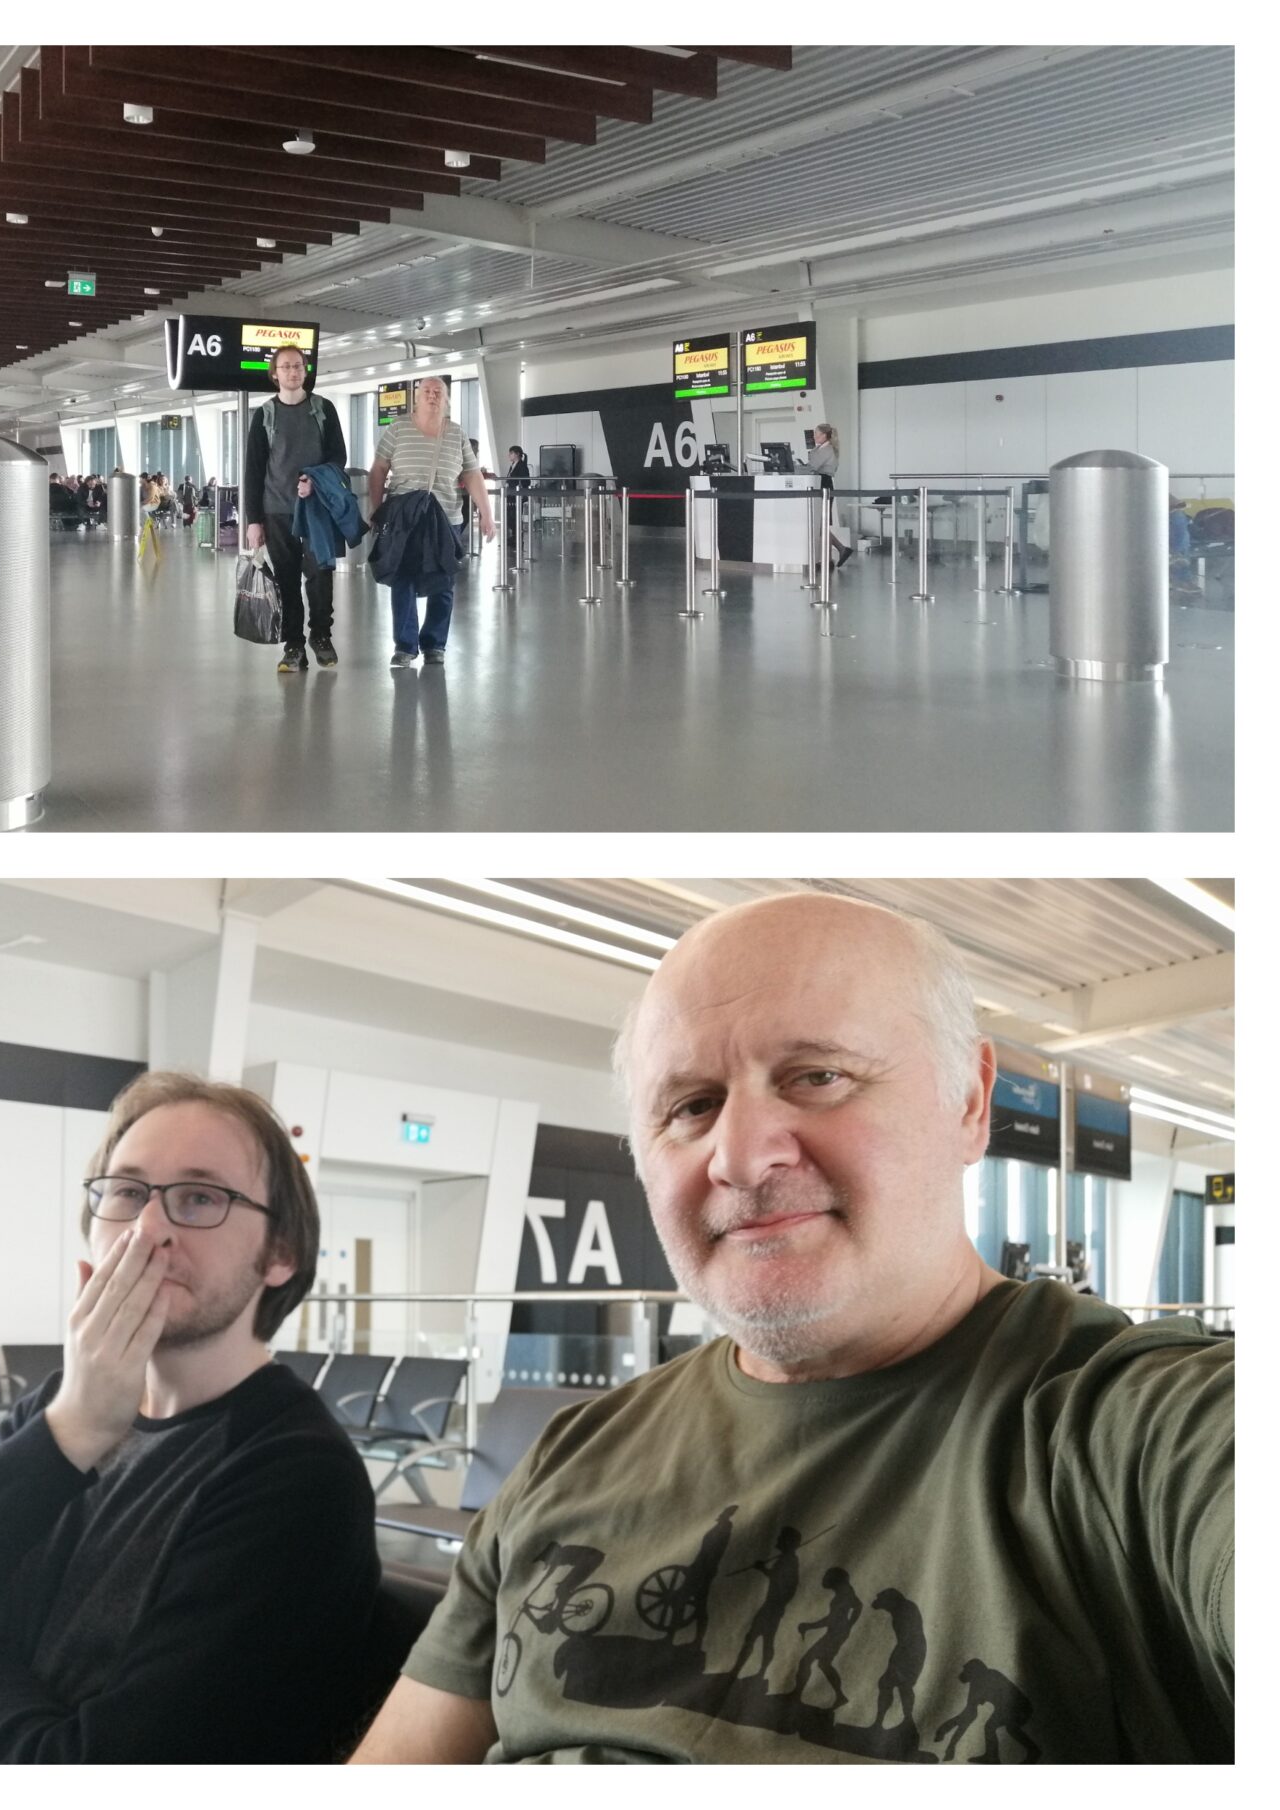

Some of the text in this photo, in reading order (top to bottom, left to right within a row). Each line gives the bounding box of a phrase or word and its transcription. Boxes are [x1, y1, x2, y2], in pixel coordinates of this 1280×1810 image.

[255, 329, 301, 340] PEGASUS
[746, 333, 756, 342] A6
[187, 333, 222, 357] A6
[756, 342, 796, 355] PEGASUS
[684, 352, 718, 364] PEGASUS
[643, 420, 698, 468] A6
